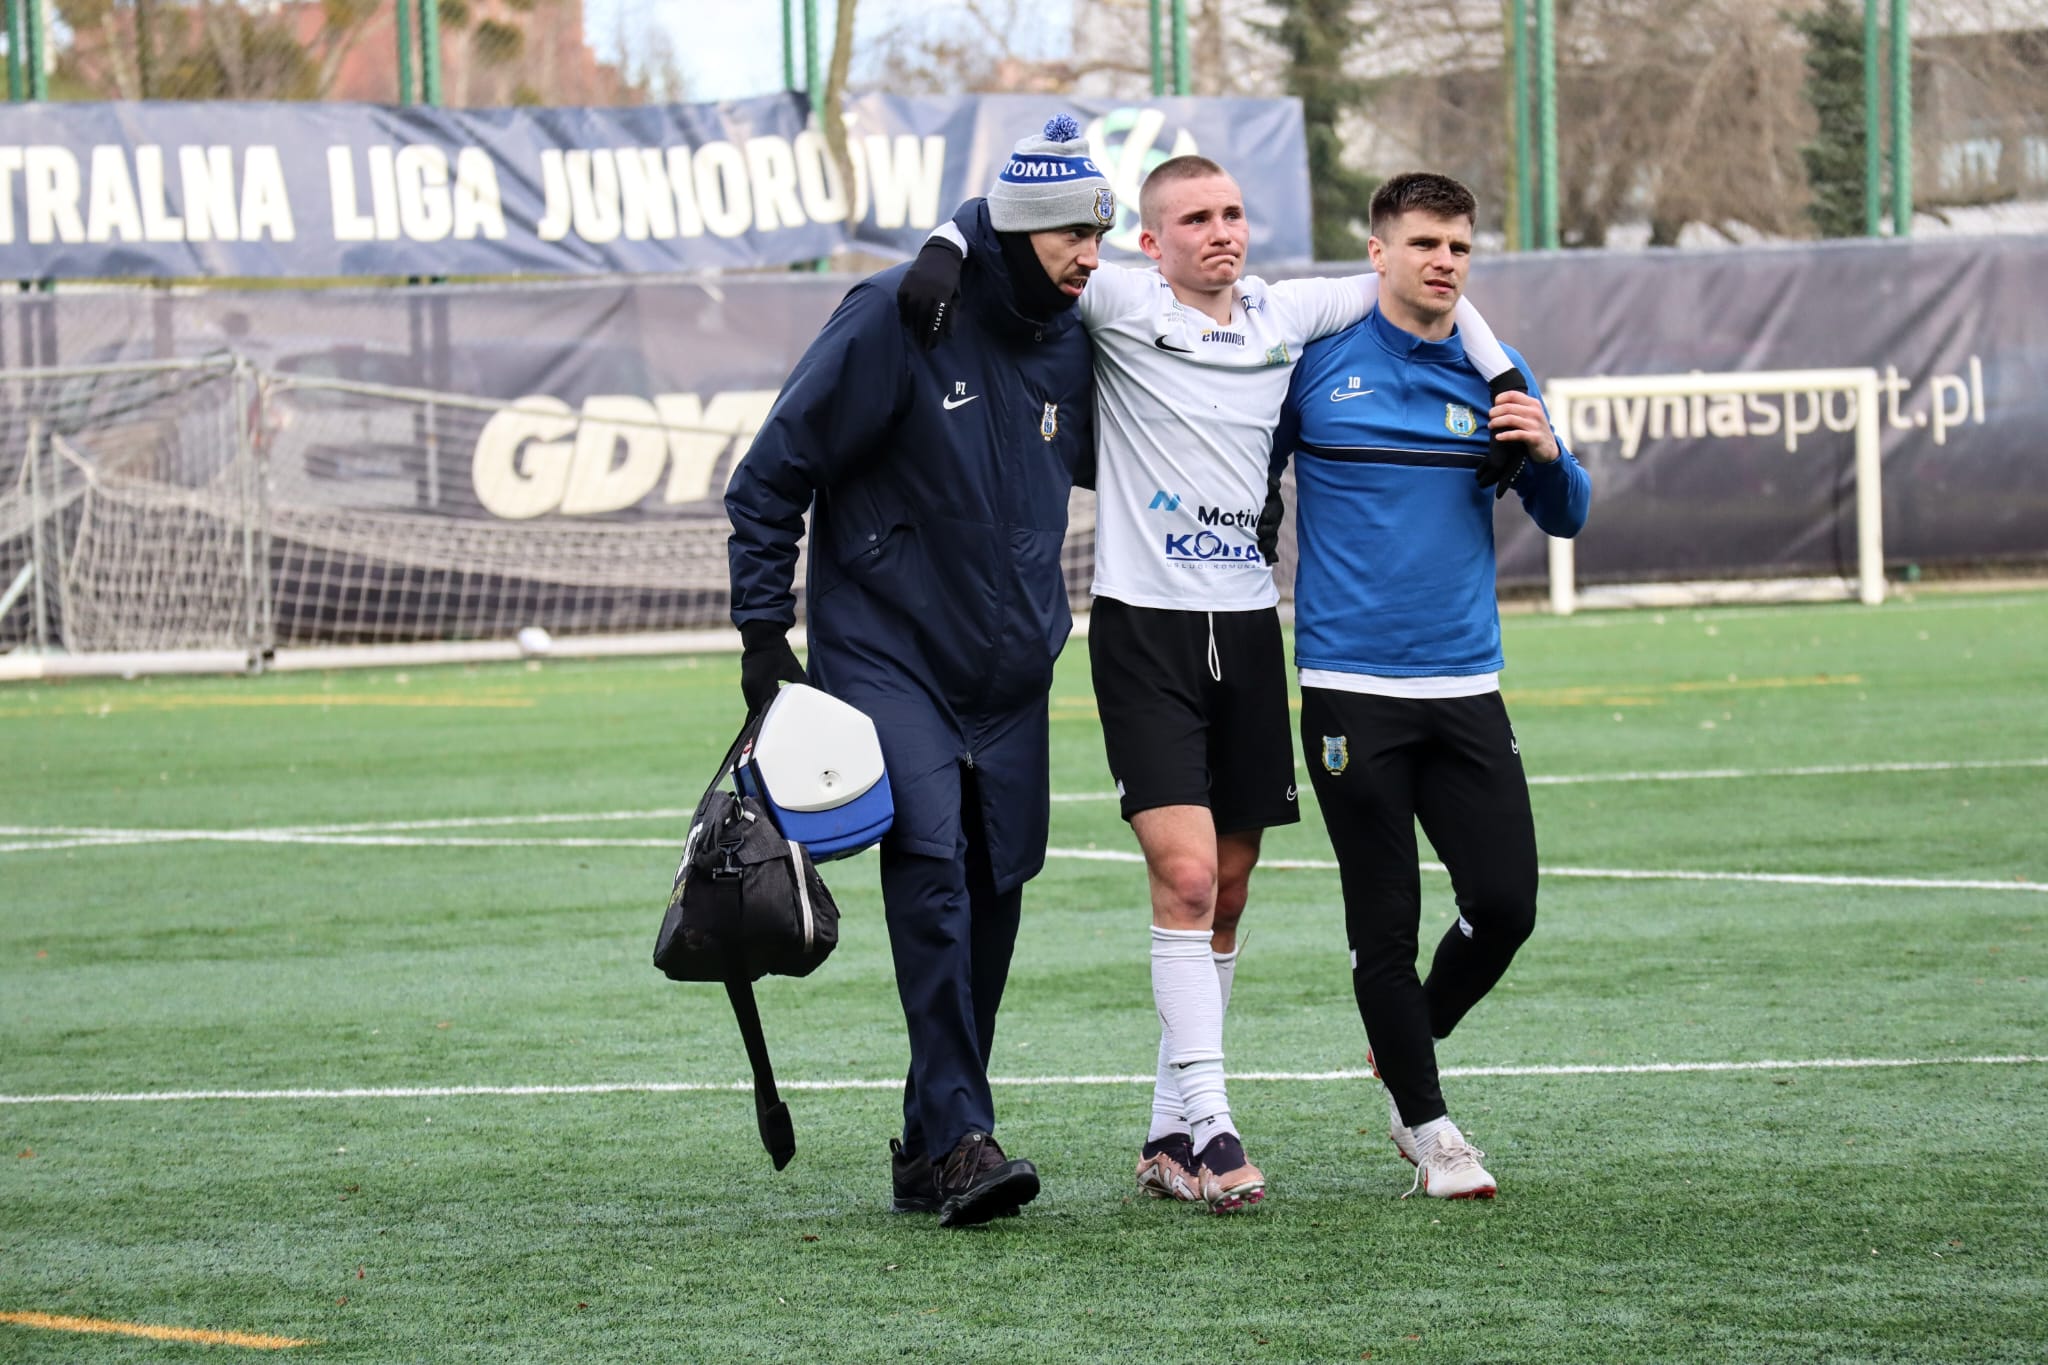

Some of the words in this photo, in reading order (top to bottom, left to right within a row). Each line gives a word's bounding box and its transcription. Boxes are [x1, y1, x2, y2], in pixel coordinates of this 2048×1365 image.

[326, 144, 508, 243] LIGA
[1347, 376, 1361, 389] 10
[1544, 355, 1986, 460] dyniaspot.pl
